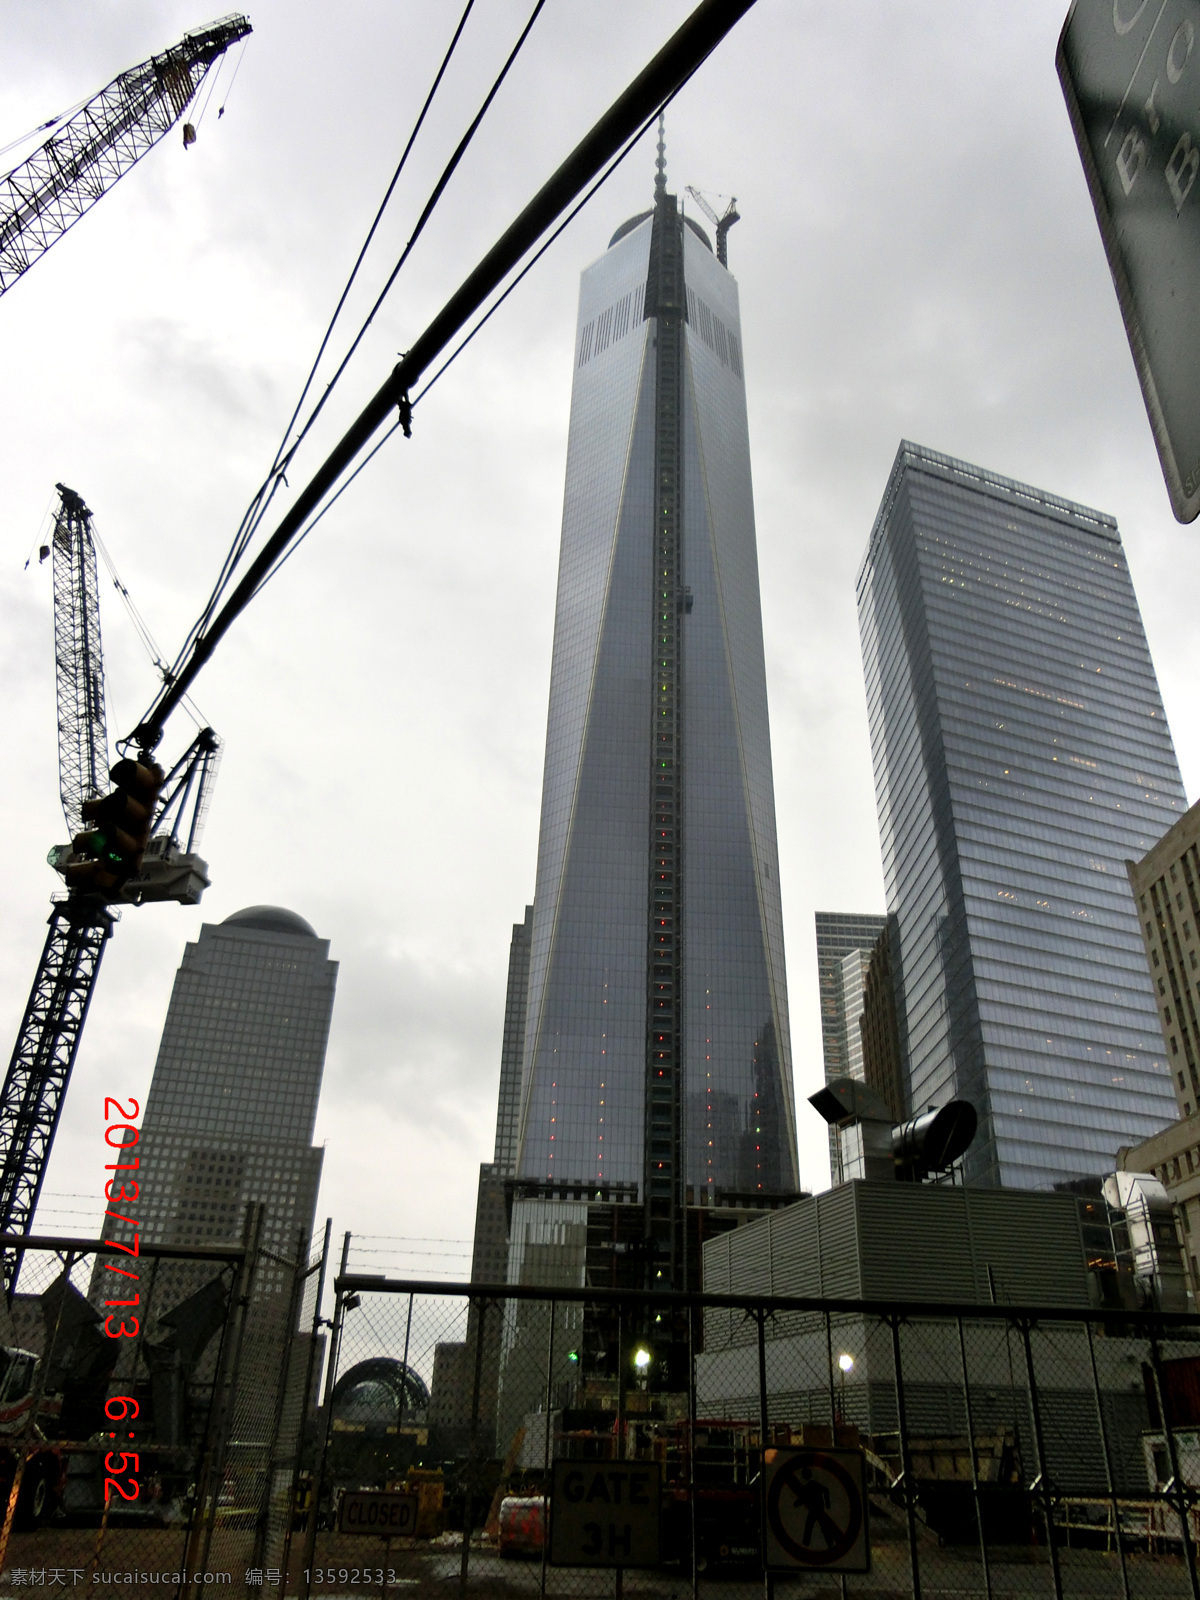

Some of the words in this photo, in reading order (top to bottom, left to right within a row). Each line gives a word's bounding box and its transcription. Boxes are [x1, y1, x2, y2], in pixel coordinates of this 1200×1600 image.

[563, 1471, 650, 1504] GATE
[348, 1502, 410, 1526] CLOSED
[582, 1522, 631, 1556] 3H
